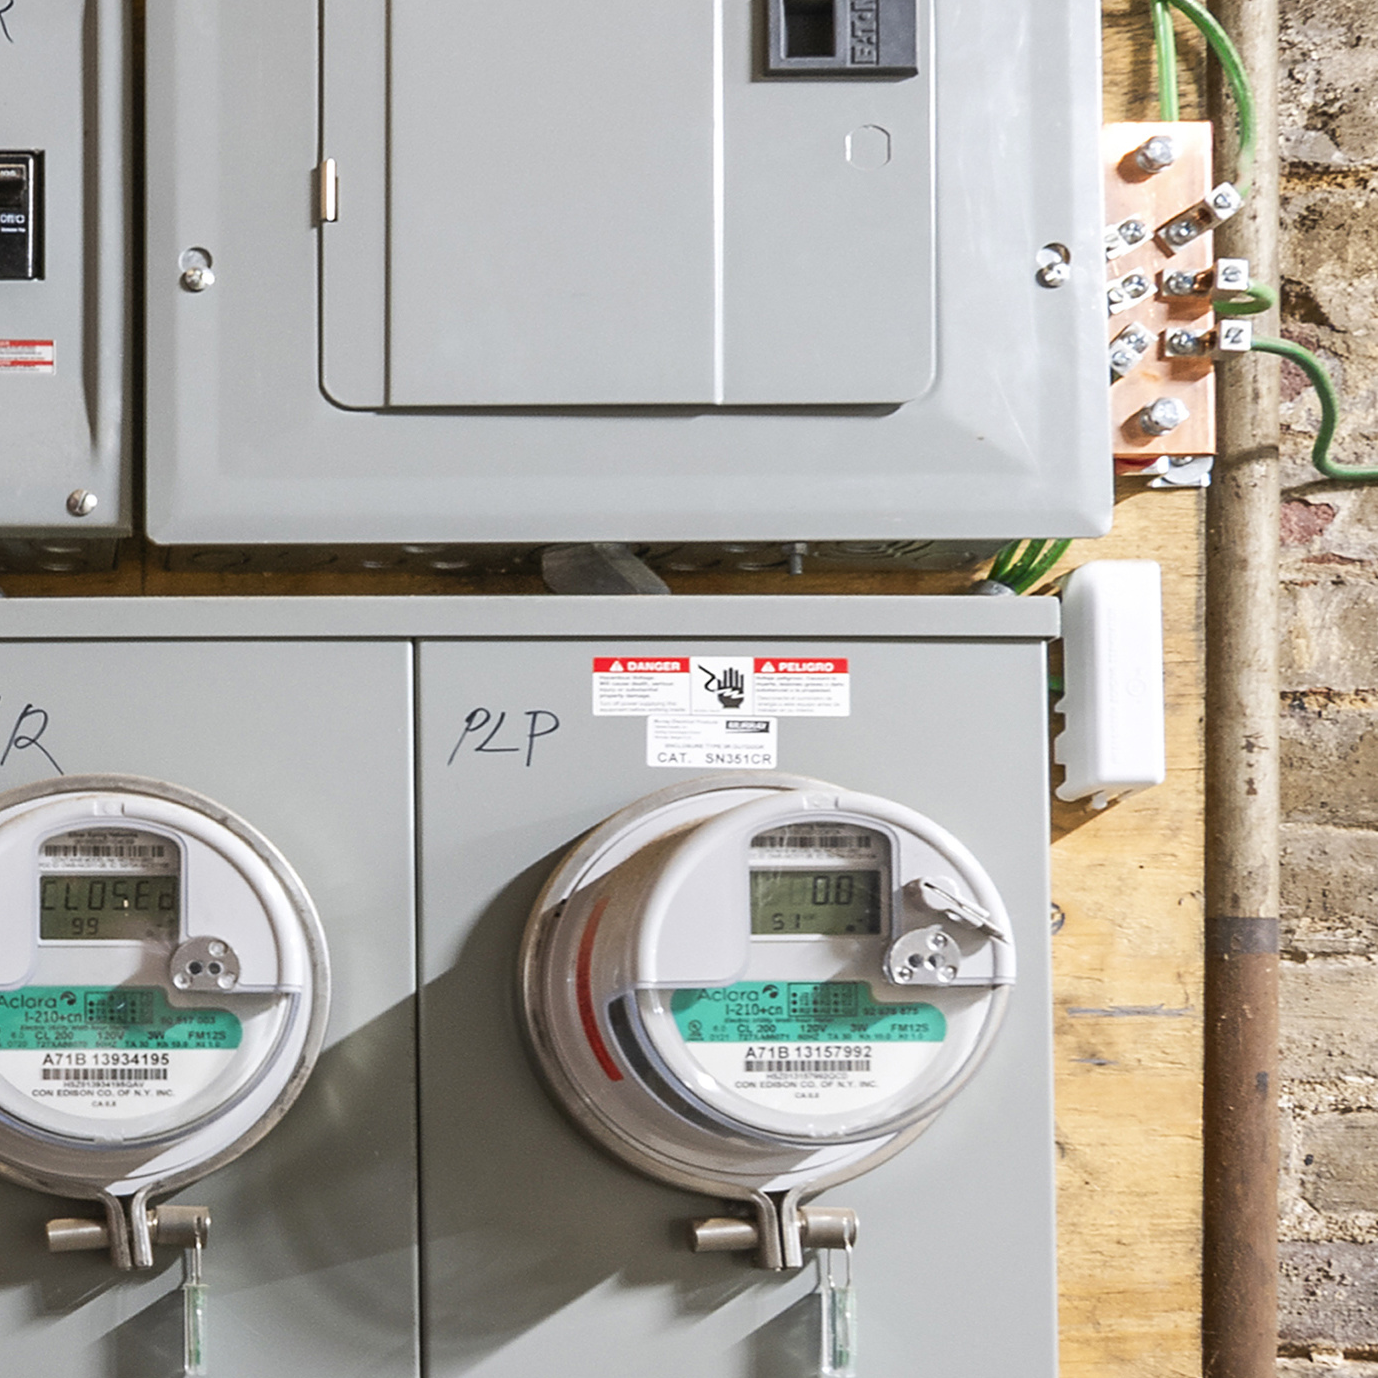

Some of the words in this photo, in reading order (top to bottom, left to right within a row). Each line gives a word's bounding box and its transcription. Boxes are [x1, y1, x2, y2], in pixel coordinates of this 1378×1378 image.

[627, 661, 681, 672] DANGER
[778, 662, 834, 672] PELIGRO
[447, 707, 560, 767] PLP
[657, 752, 692, 763] CAT.
[705, 753, 772, 765] SN351CR
[72, 918, 99, 935] 99
[698, 988, 759, 1002] Aclara
[890, 1023, 929, 1033] FM12S
[188, 1031, 226, 1040] FM12S
[745, 1046, 789, 1059] A71B
[795, 1046, 872, 1059] 13157992
[42, 1053, 87, 1066] A71B
[93, 1053, 170, 1066] 13934195
[735, 1081, 756, 1089] CON
[760, 1081, 797, 1089] EDISON
[821, 1081, 834, 1089] OF
[32, 1089, 54, 1097] CON
[57, 1089, 94, 1097] EDISON
[117, 1089, 130, 1097] OF
